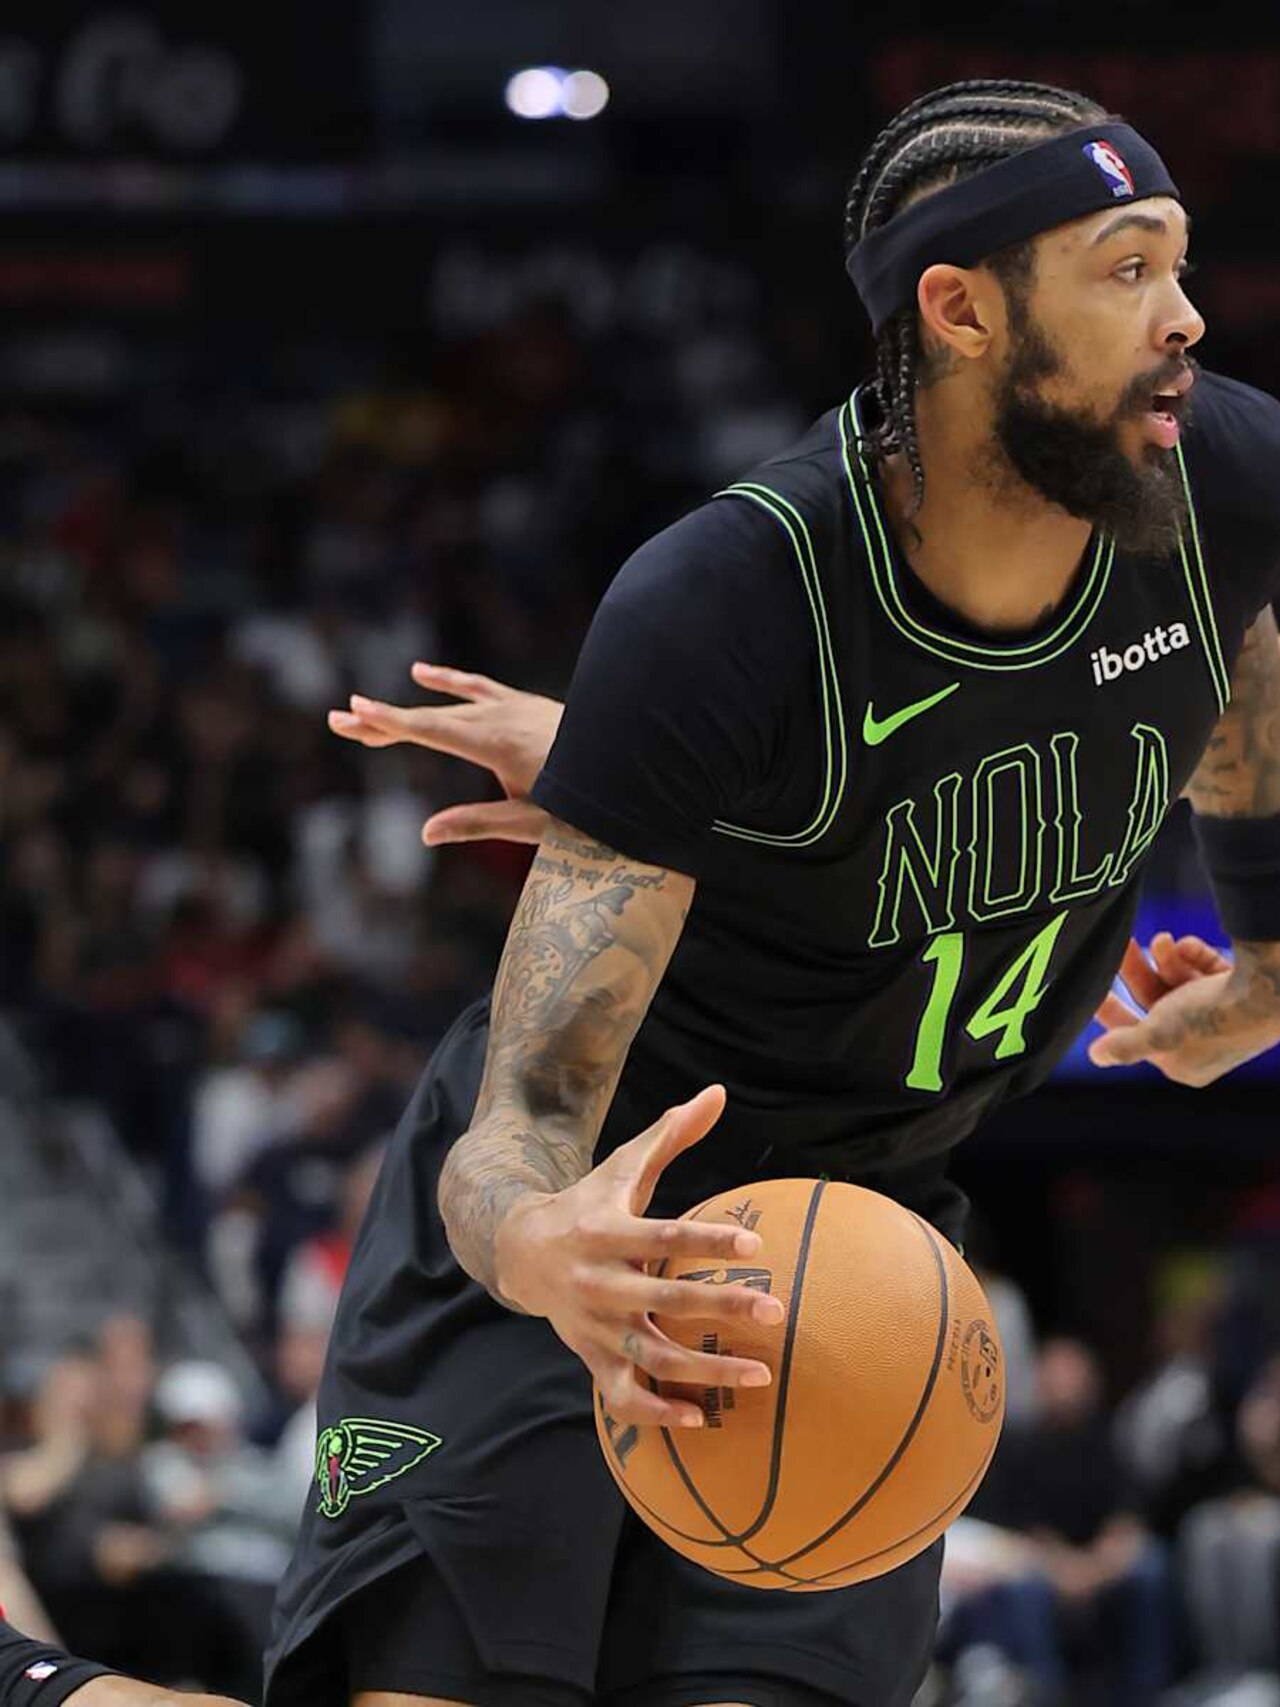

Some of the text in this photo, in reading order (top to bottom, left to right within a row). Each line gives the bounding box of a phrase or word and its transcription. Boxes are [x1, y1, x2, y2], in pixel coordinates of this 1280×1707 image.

[1091, 623, 1190, 686] ibotta
[869, 723, 1169, 947] NOLA
[905, 909, 1070, 1092] 14
